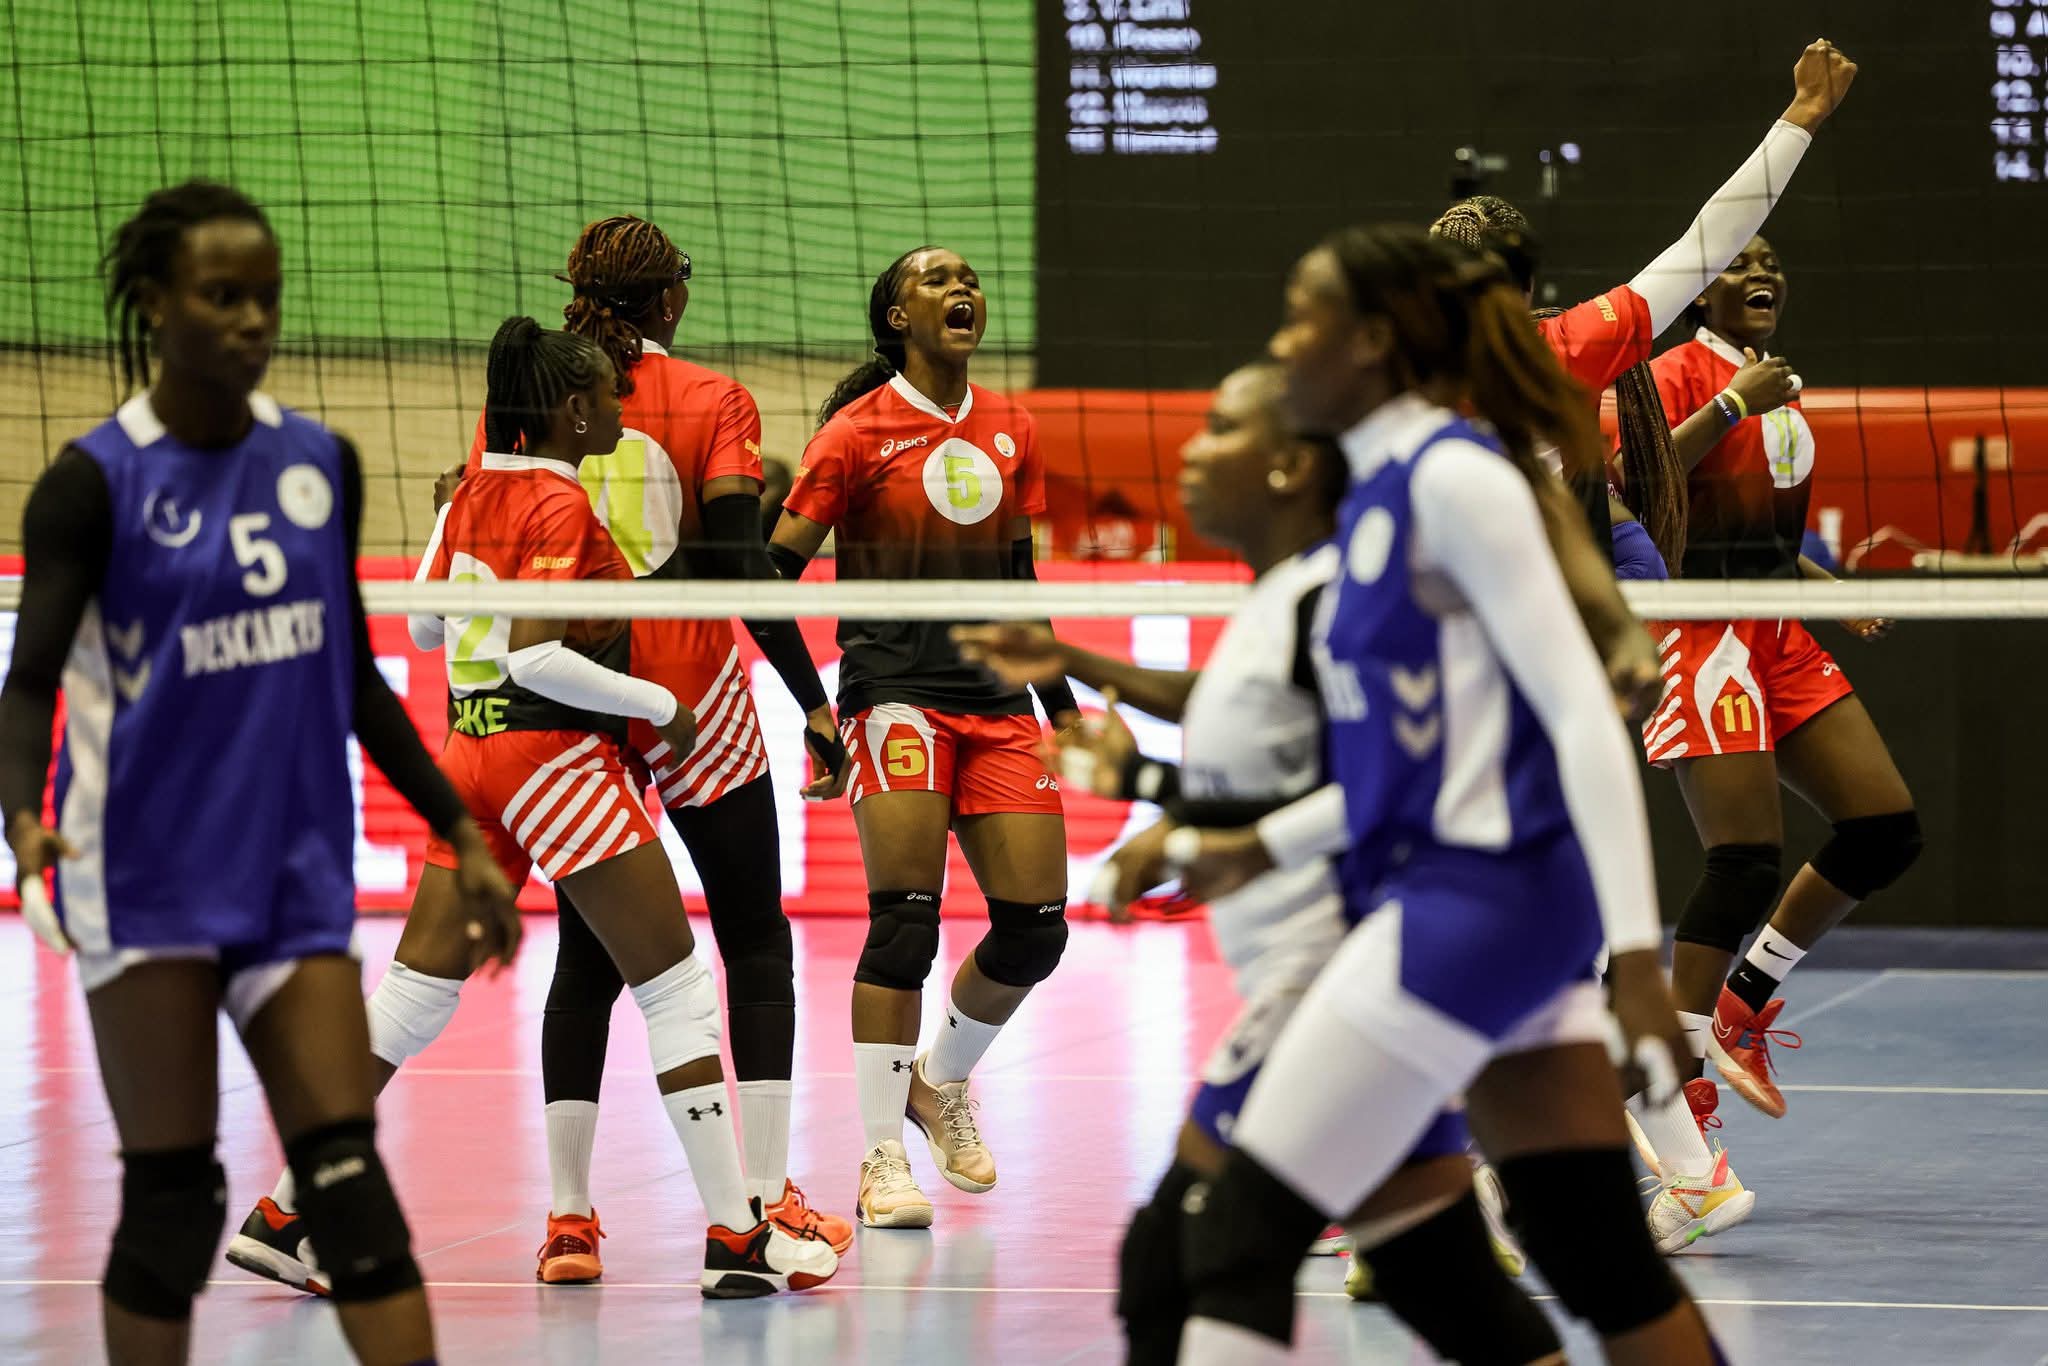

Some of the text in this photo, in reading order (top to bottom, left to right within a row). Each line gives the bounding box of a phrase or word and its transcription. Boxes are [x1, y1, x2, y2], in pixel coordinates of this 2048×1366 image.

[895, 435, 928, 451] asics
[944, 456, 982, 509] 5
[229, 512, 288, 597] 5
[452, 572, 501, 685] 2
[1718, 694, 1753, 732] 11
[887, 737, 926, 777] 5
